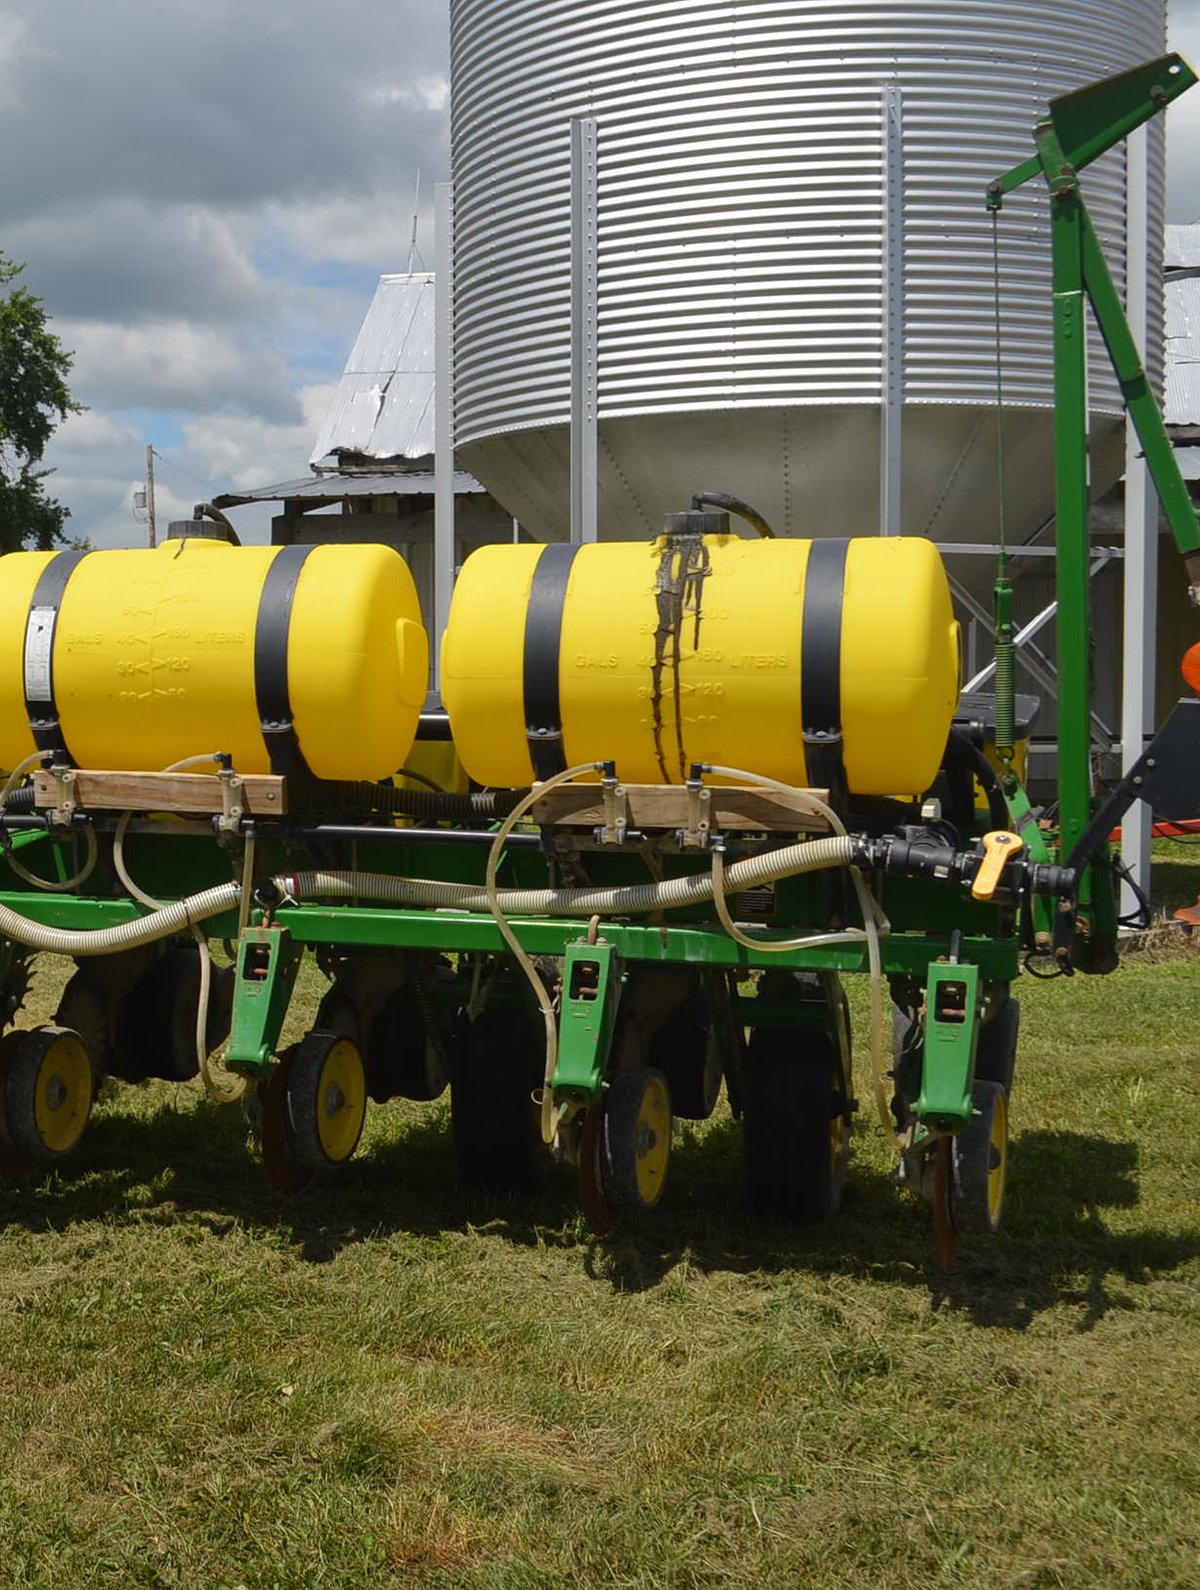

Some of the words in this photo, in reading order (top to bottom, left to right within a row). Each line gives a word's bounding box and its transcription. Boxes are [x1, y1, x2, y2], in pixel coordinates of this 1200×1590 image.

[194, 631, 246, 645] LITERS
[574, 652, 619, 670] GALS
[730, 652, 788, 670] LITERS
